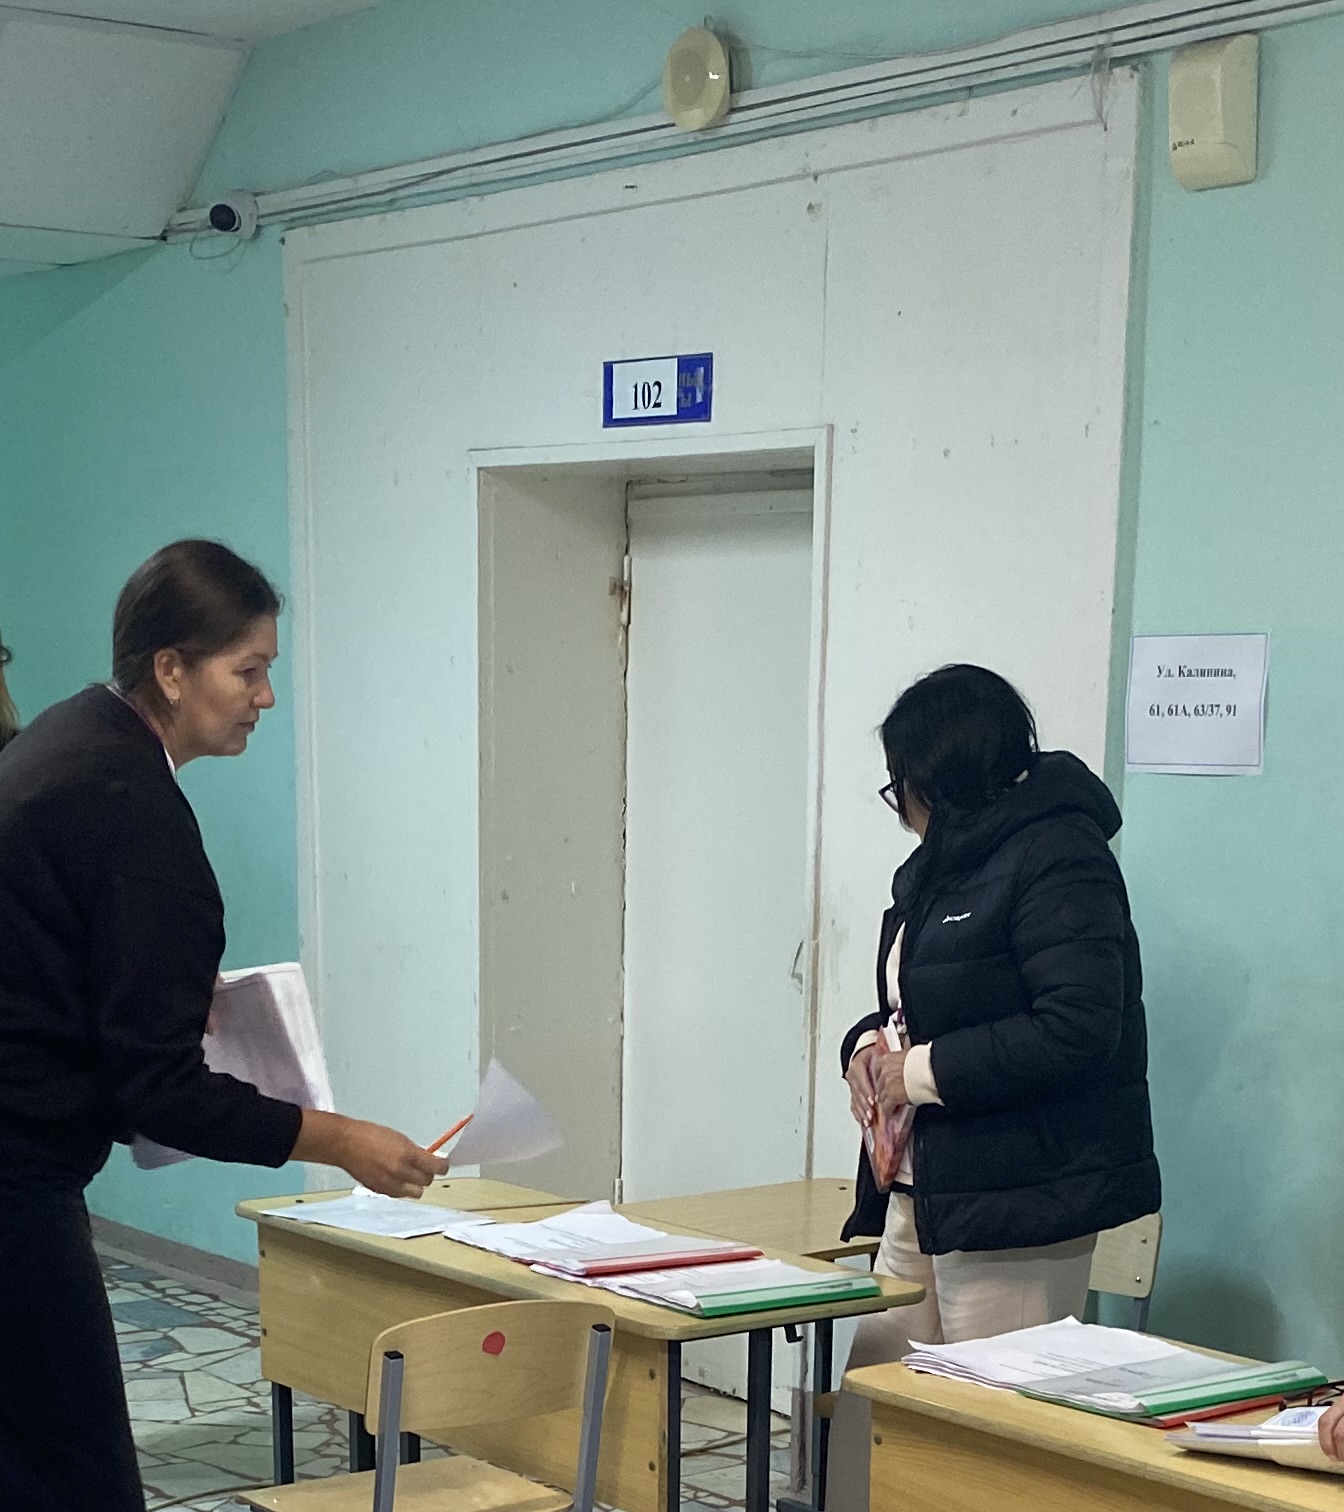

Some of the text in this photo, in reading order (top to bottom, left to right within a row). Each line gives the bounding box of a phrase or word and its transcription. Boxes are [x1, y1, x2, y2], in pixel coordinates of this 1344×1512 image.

[632, 381, 663, 410] 102
[1157, 665, 1236, 679] Ул. Калинина,
[1149, 704, 1165, 719] 61,
[1167, 704, 1191, 719] 61А,
[1225, 704, 1237, 717] 91
